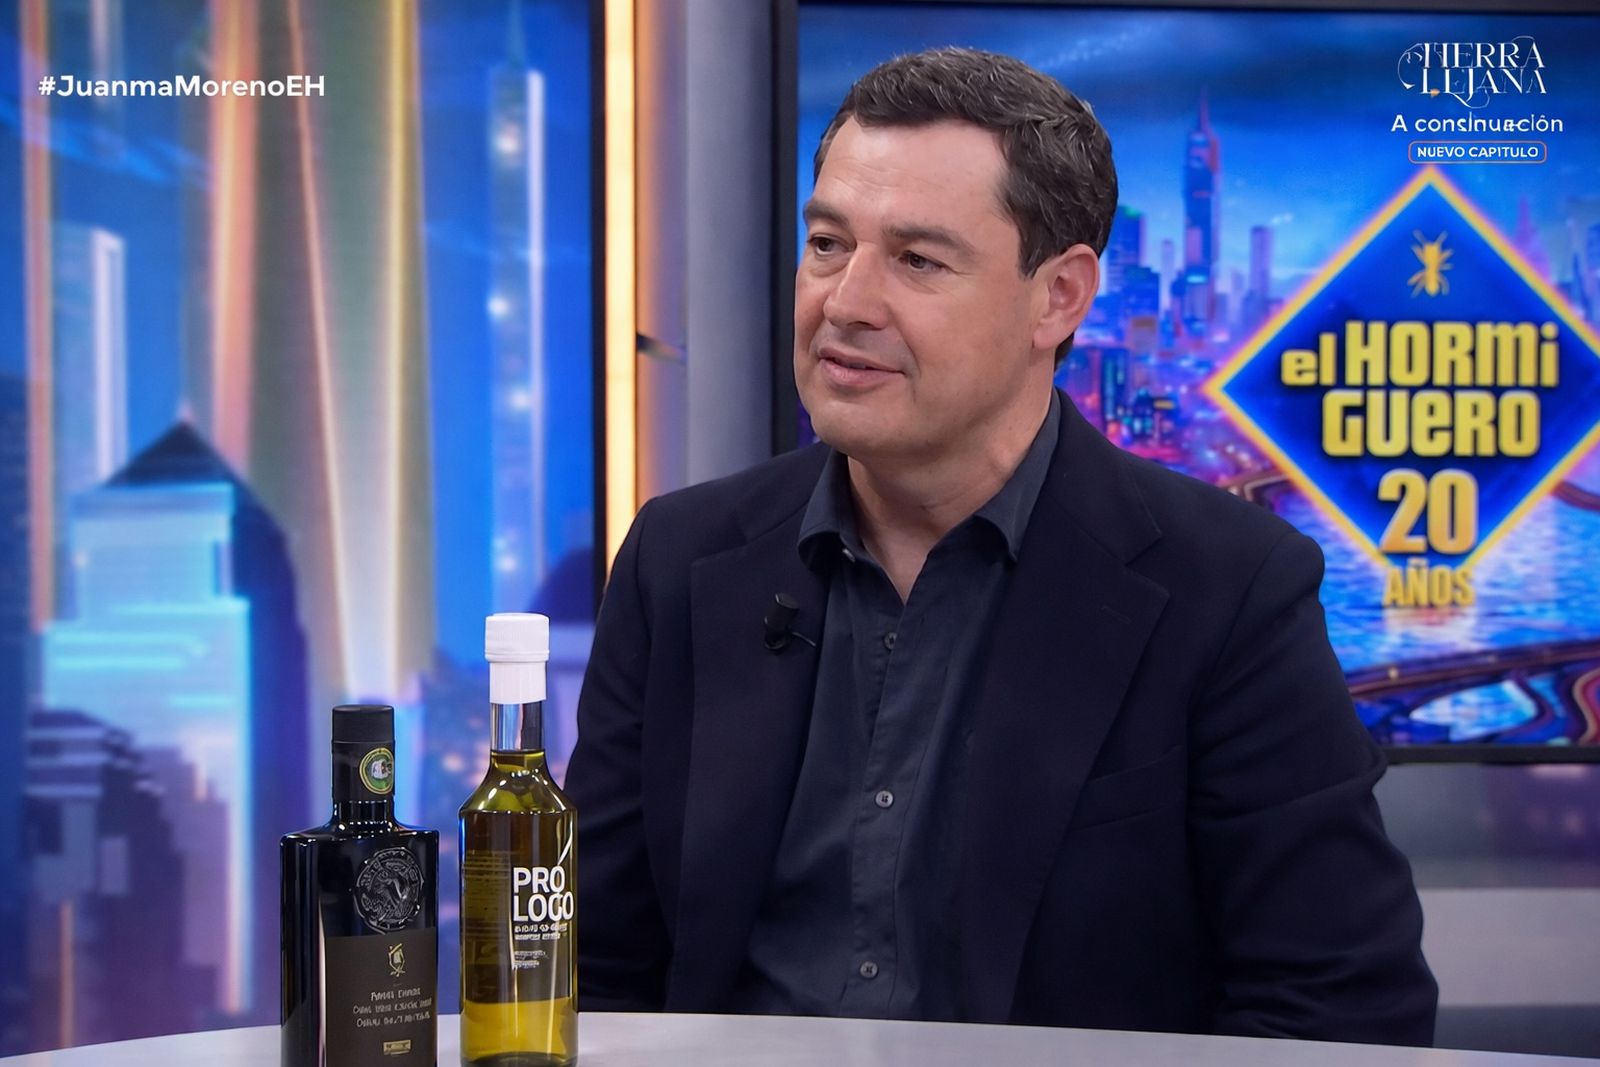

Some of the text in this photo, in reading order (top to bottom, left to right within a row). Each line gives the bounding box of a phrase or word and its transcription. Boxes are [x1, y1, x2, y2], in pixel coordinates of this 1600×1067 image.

[1281, 333, 1337, 386] el
[1378, 469, 1479, 554] 20
[1383, 558, 1475, 608] AÑOS
